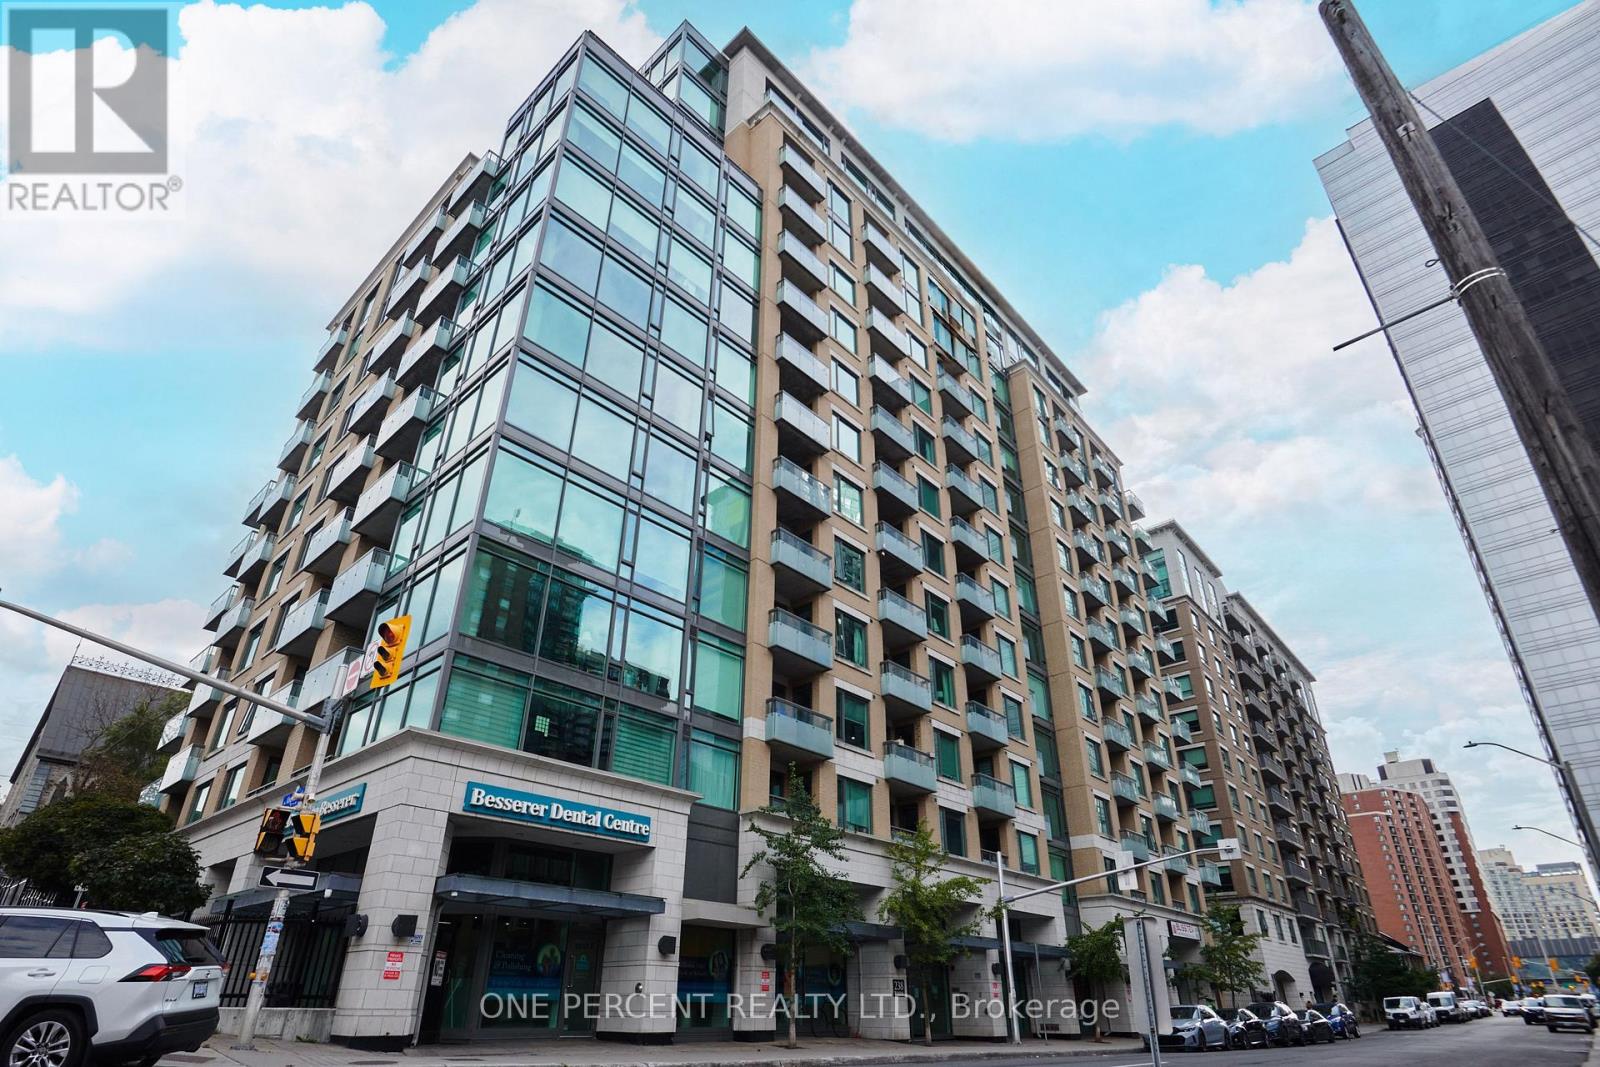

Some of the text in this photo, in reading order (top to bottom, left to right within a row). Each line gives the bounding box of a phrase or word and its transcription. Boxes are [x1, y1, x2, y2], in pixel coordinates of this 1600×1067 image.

[470, 787, 650, 836] Besserer Dental Centre
